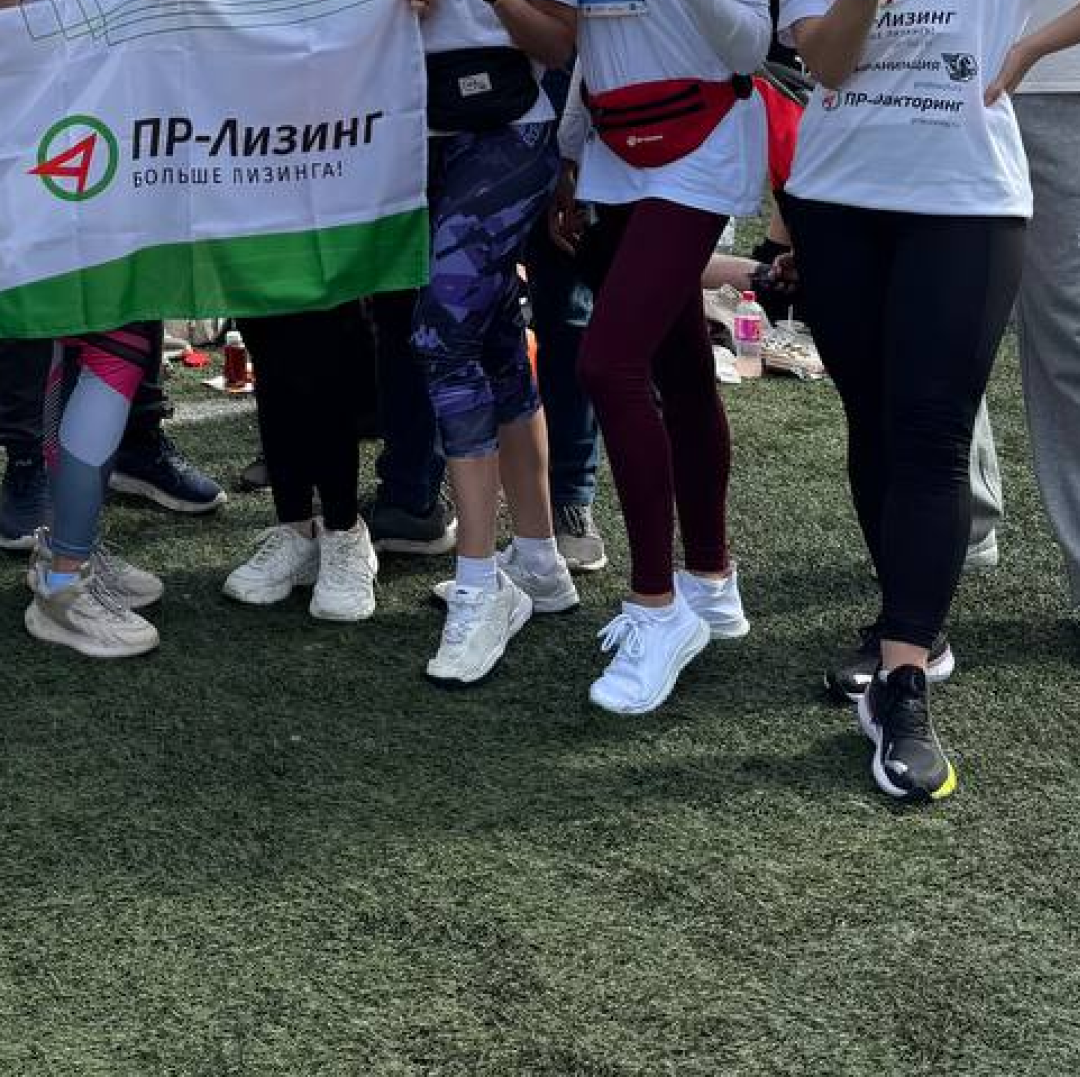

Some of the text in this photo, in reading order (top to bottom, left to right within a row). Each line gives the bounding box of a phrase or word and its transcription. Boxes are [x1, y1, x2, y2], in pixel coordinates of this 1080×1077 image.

[877, 11, 958, 29] Лизинг
[131, 110, 385, 162] ПР-Лизинг
[132, 166, 224, 189] БОЛЬШЕ
